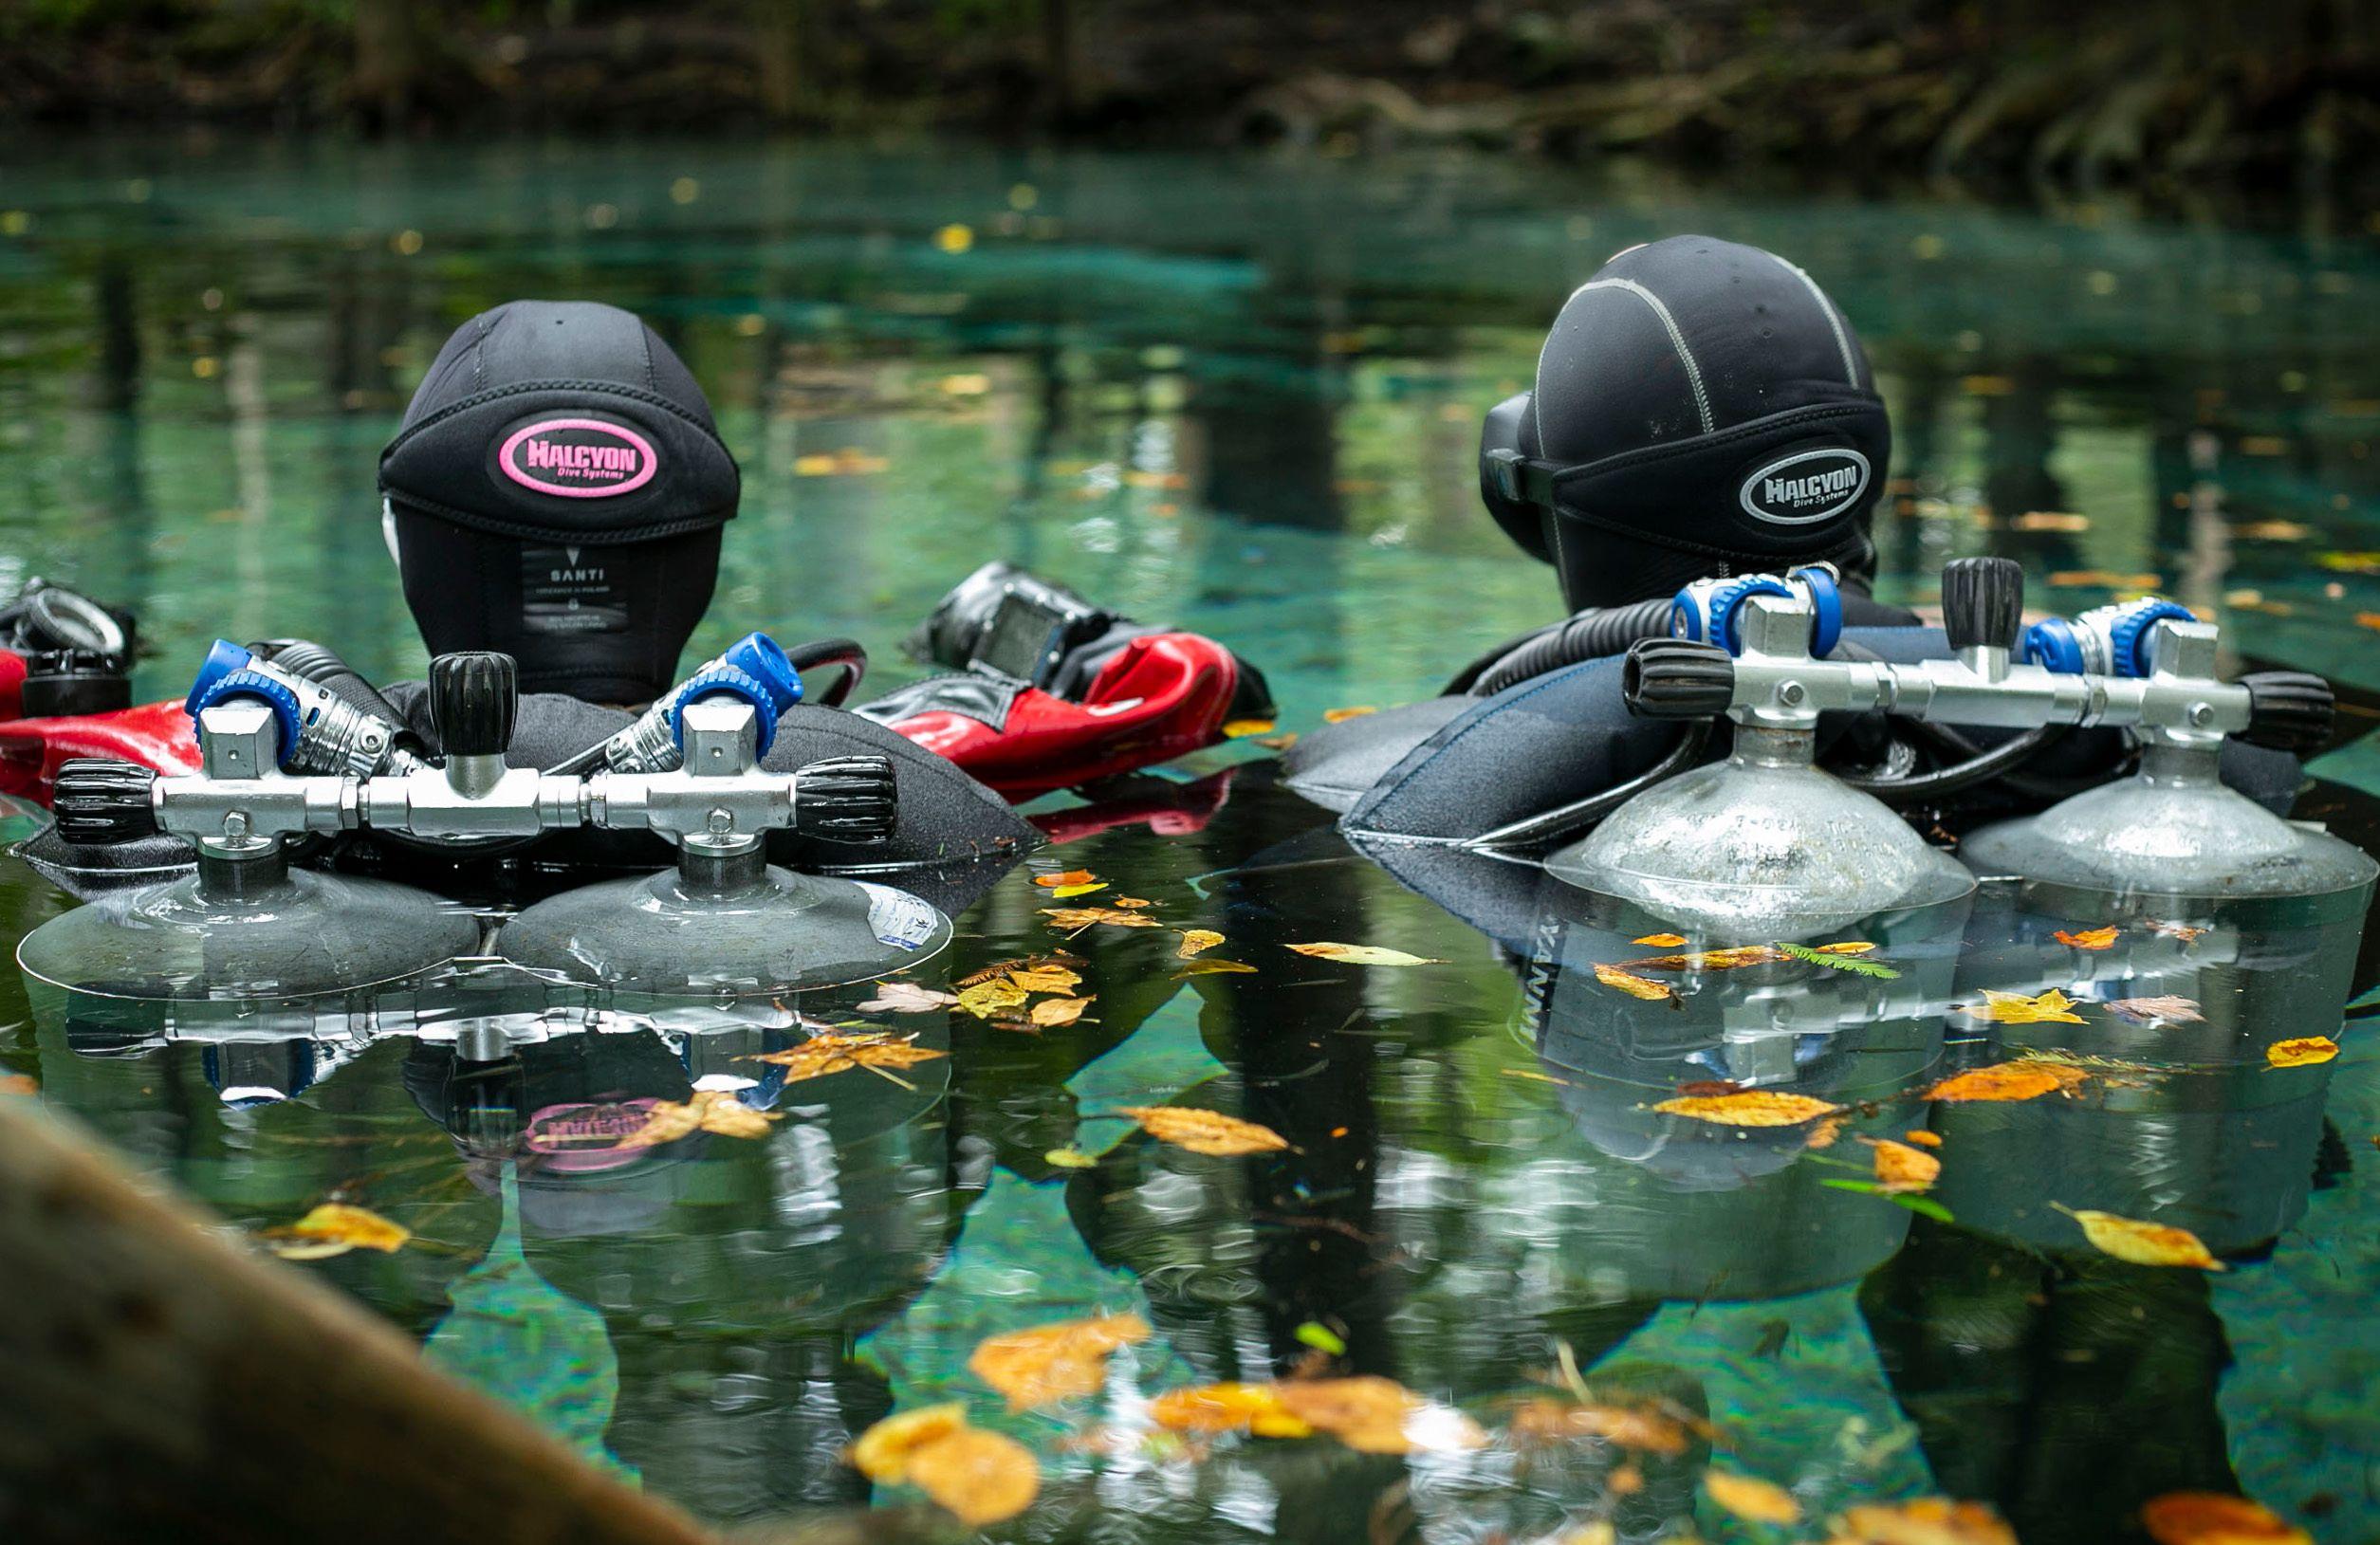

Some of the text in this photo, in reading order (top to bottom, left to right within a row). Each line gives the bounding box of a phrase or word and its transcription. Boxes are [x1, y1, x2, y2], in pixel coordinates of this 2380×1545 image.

[526, 438, 636, 472] HALCYON
[557, 467, 625, 481] Dive Systems
[1764, 465, 1857, 505] HALCYON
[1793, 488, 1850, 508] Dive Systems
[550, 568, 604, 582] SANTI
